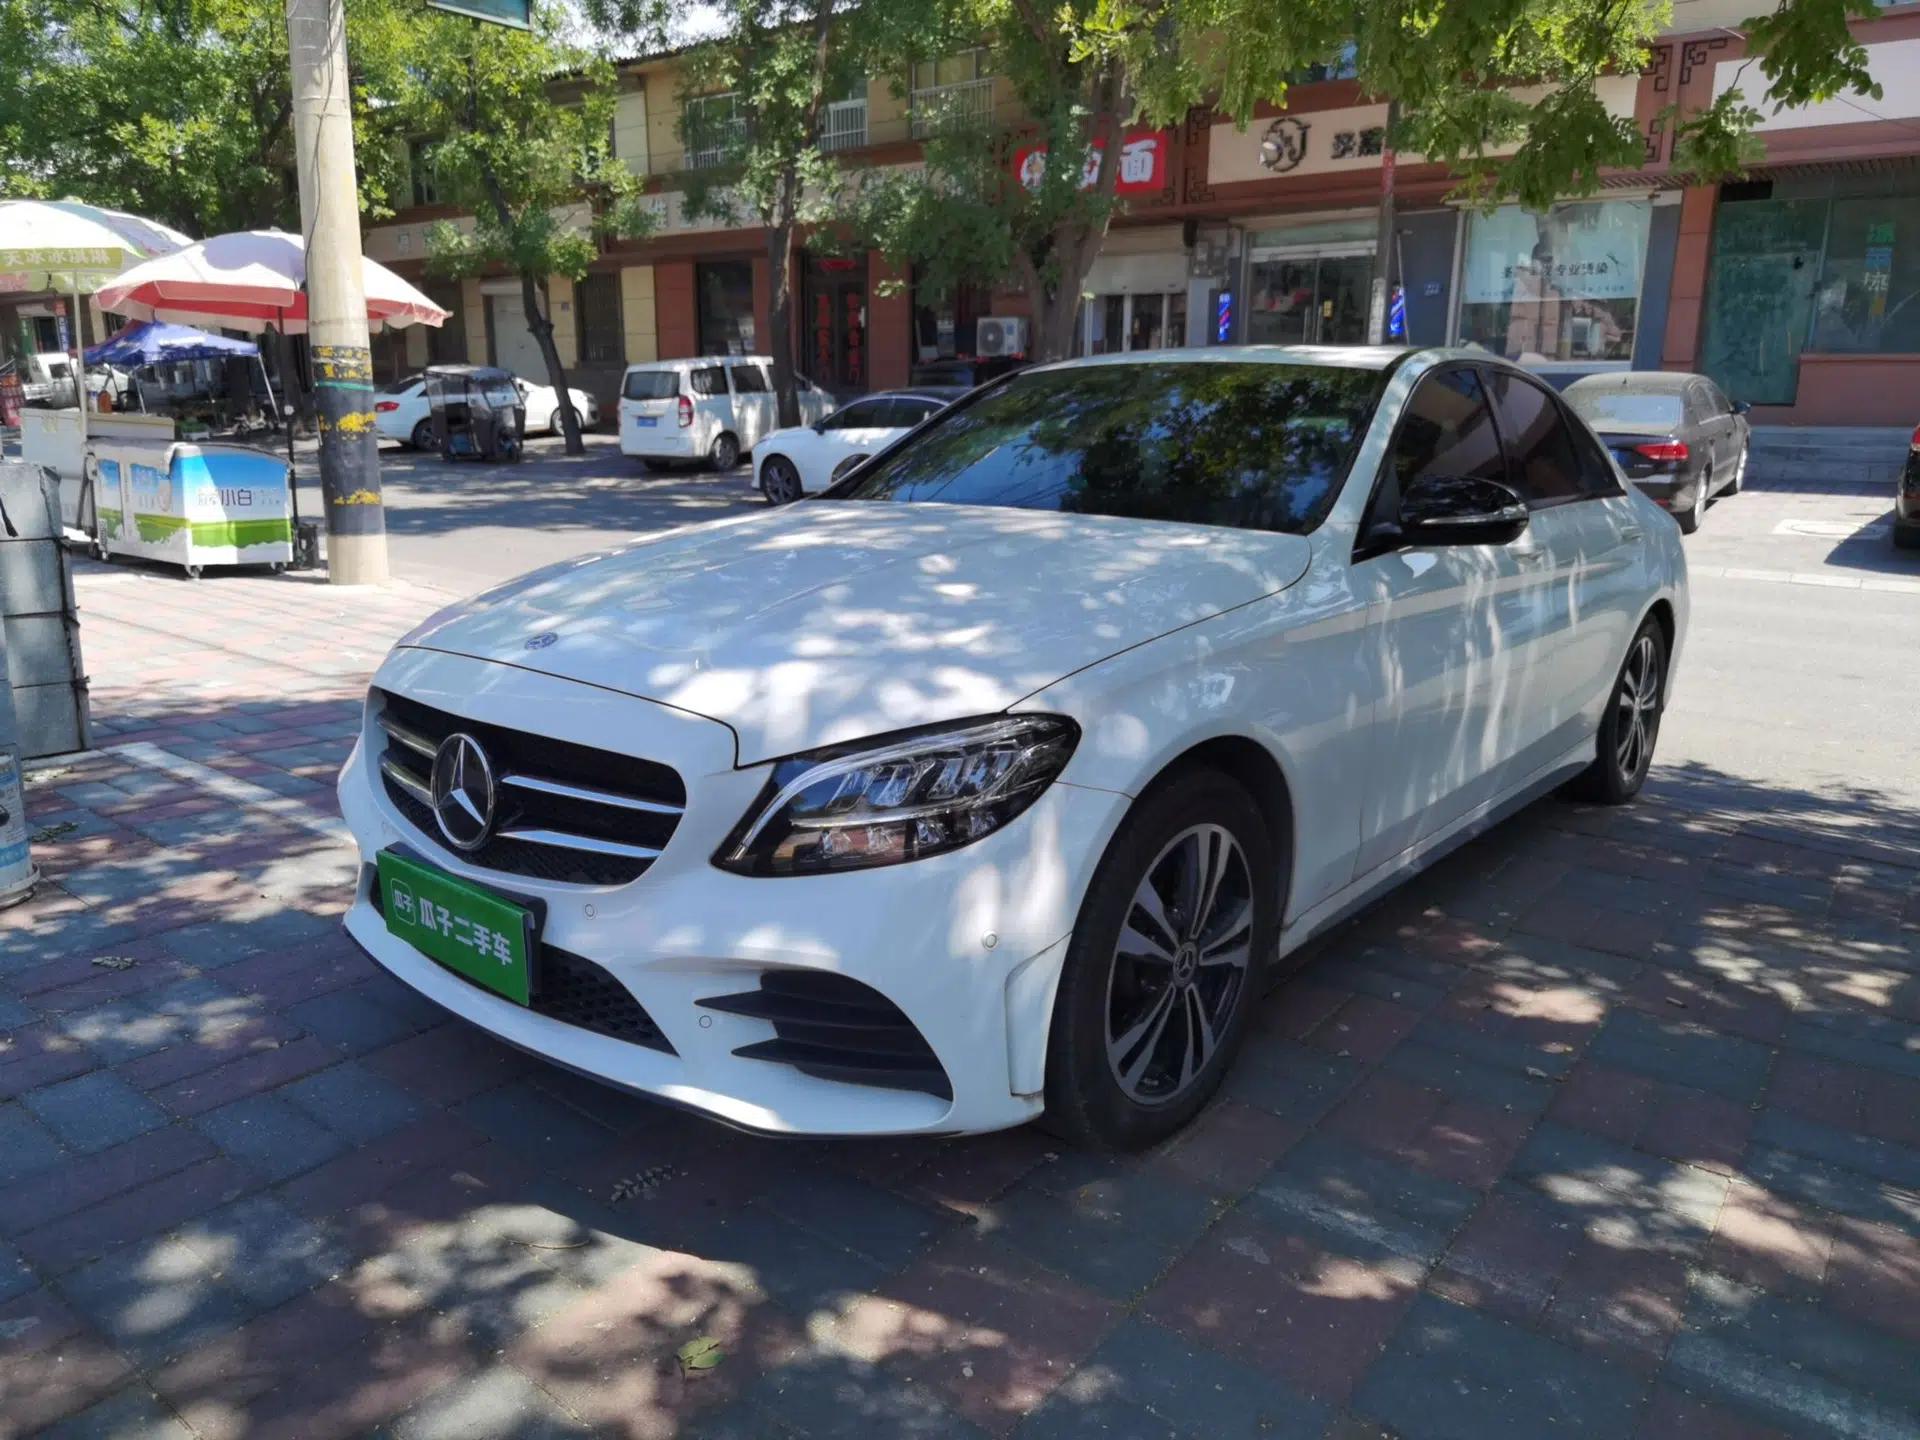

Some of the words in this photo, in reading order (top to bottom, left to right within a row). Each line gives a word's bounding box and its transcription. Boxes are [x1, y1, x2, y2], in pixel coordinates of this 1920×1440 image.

[394, 889, 415, 912] 瓜子
[419, 896, 513, 966] 瓜子二手车
